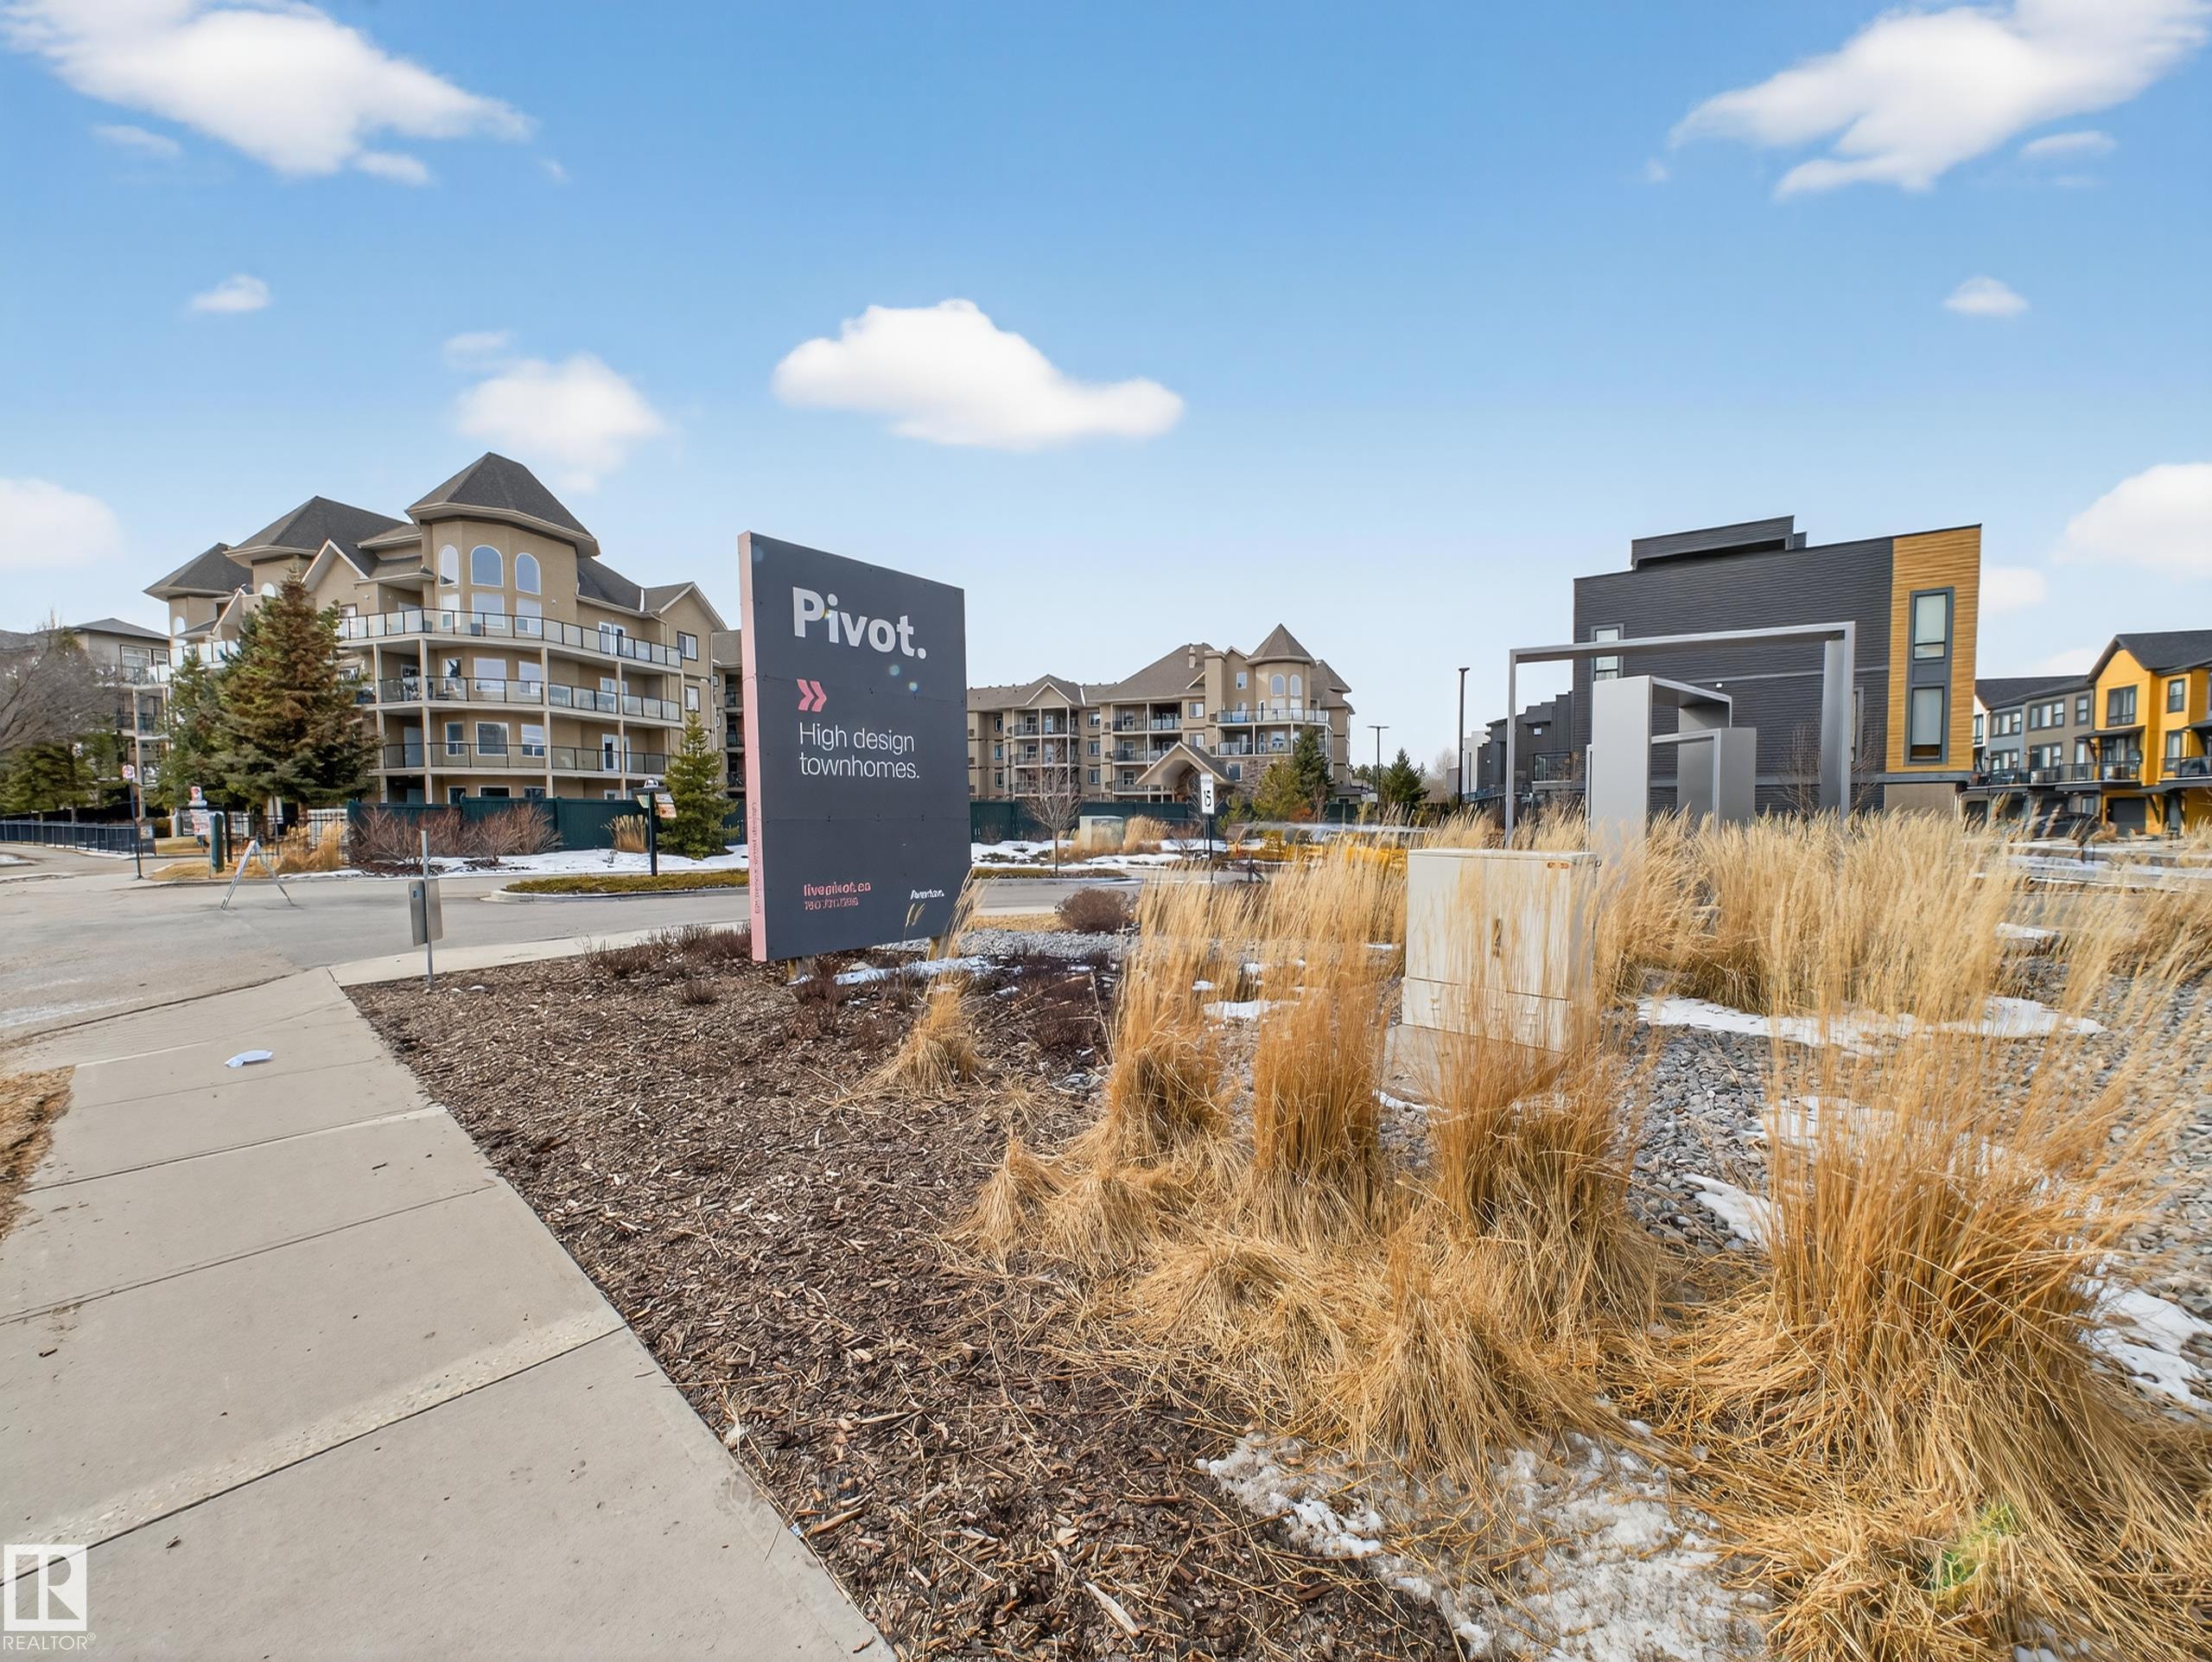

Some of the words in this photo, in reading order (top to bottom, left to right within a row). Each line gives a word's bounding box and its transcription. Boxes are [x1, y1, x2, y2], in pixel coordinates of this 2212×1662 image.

[792, 586, 927, 659] Pivot.
[799, 722, 848, 751] High
[853, 727, 915, 755] design
[798, 751, 920, 779] townhomes.
